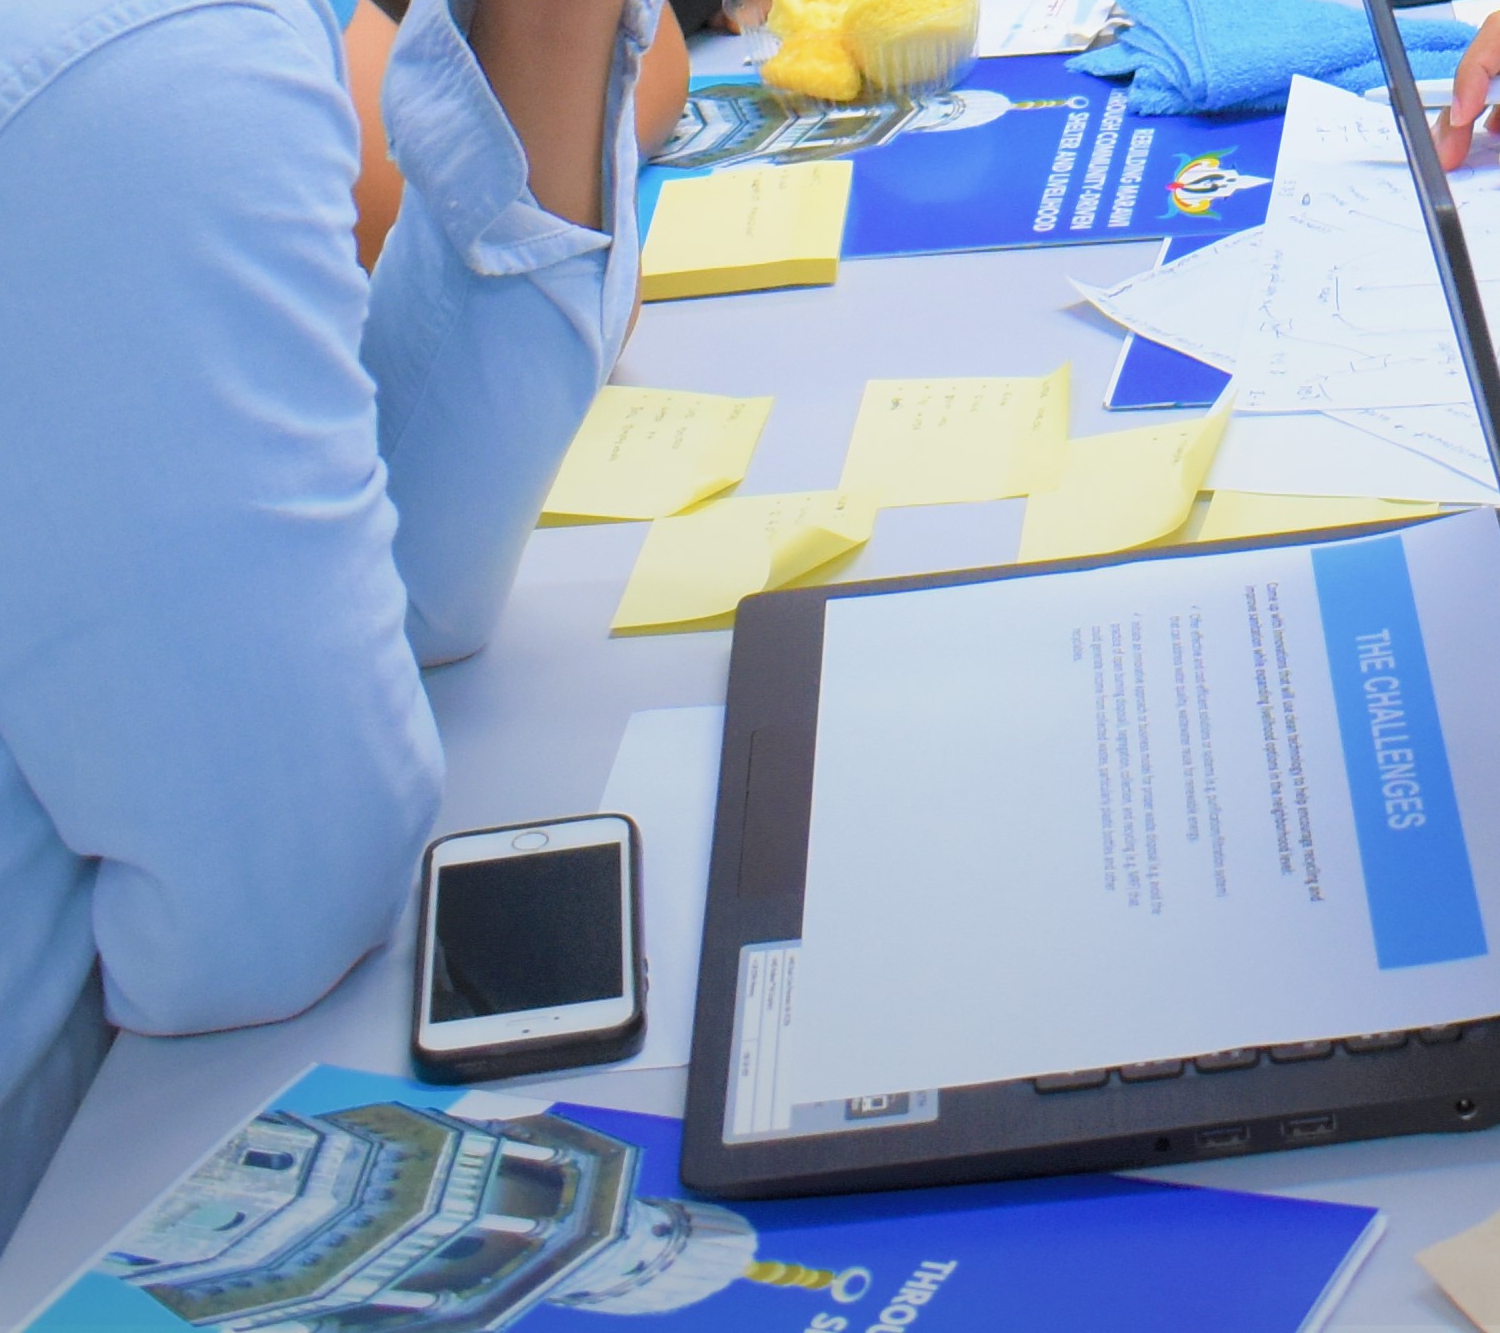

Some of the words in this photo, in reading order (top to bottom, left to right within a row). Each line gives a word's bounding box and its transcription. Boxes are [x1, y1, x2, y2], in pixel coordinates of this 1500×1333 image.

[1057, 111, 1090, 150] SHELTER
[1051, 150, 1078, 173] AND
[1032, 173, 1071, 233] LIVELIHOOD
[1352, 628, 1395, 672] THE
[1361, 675, 1424, 829] CHALLENGES
